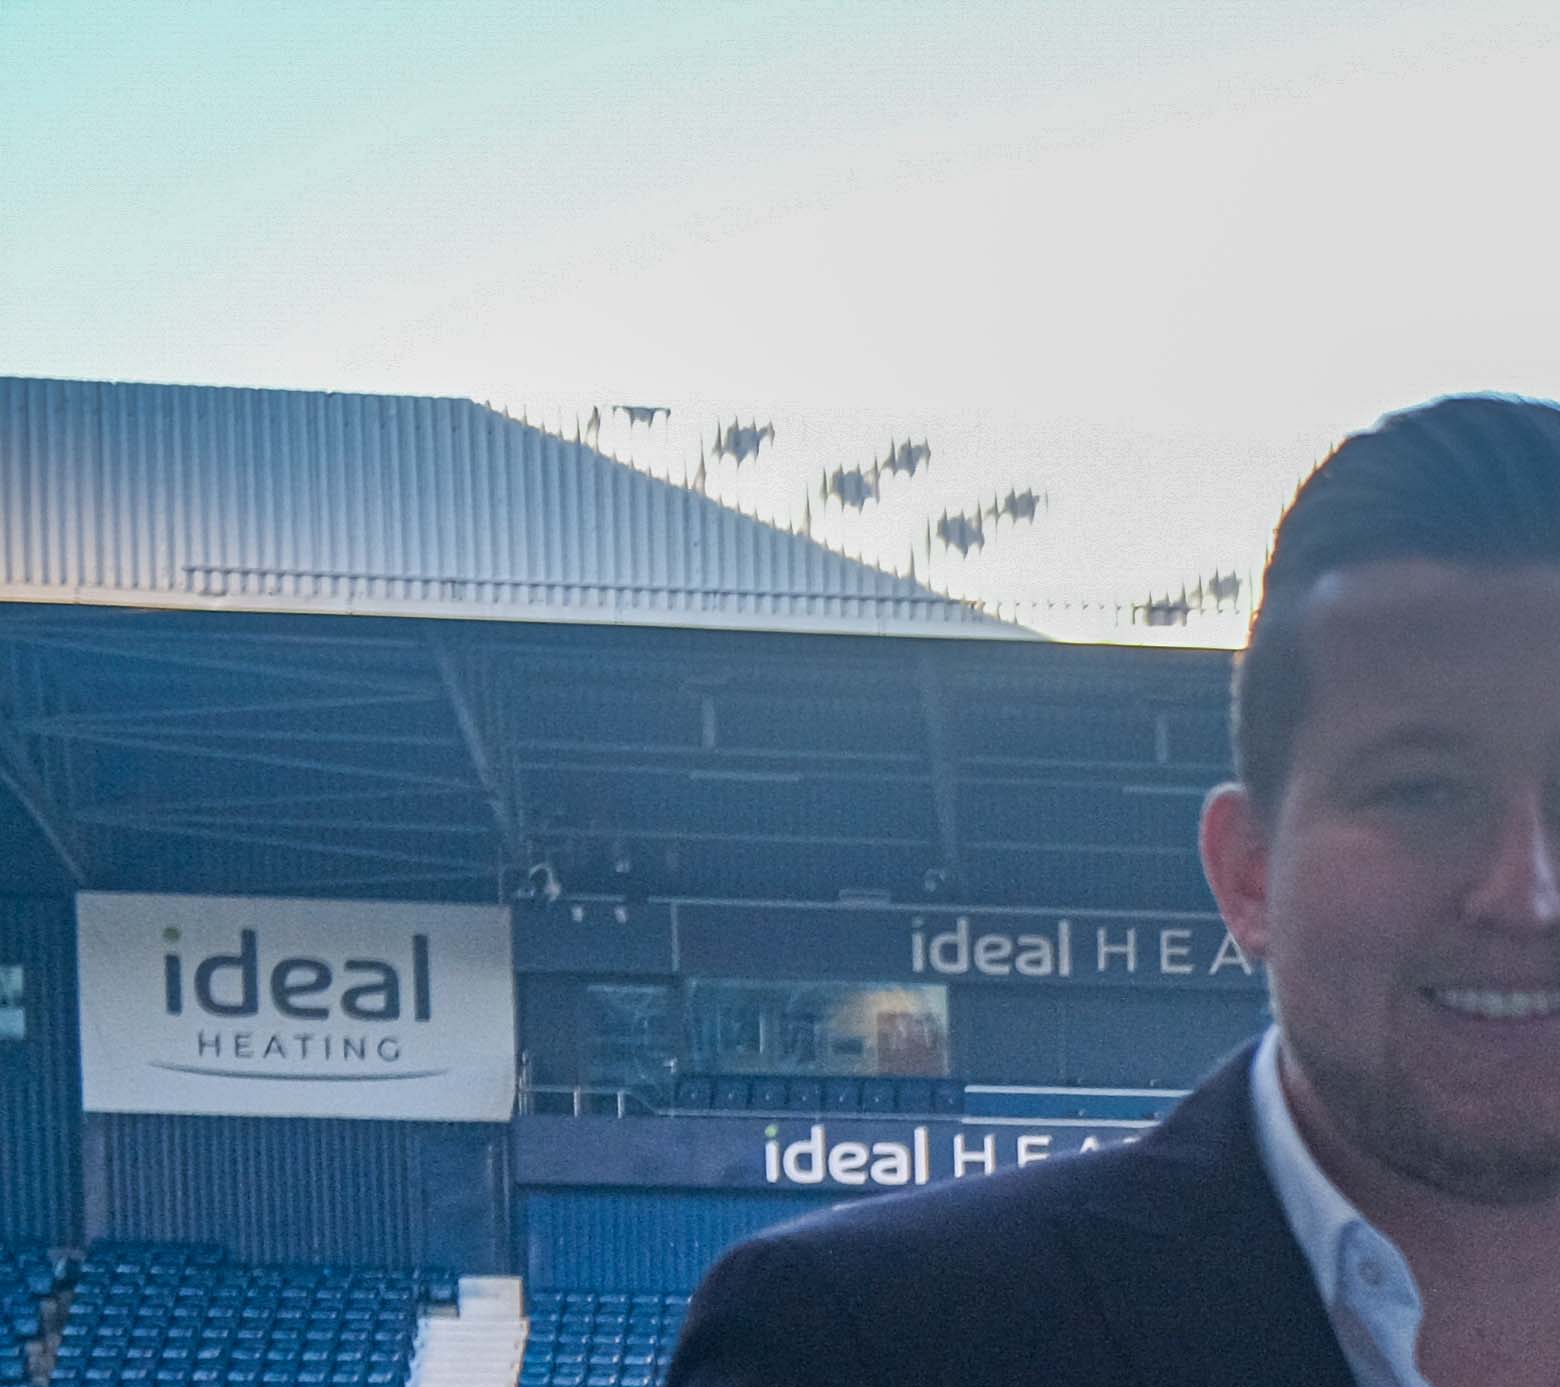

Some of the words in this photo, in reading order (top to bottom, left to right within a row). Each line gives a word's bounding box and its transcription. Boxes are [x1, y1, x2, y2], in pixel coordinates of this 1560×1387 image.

[162, 925, 431, 1023] ideal
[911, 915, 1072, 978] ideal
[197, 1031, 404, 1064] HEATING
[764, 1122, 930, 1185] ideal
